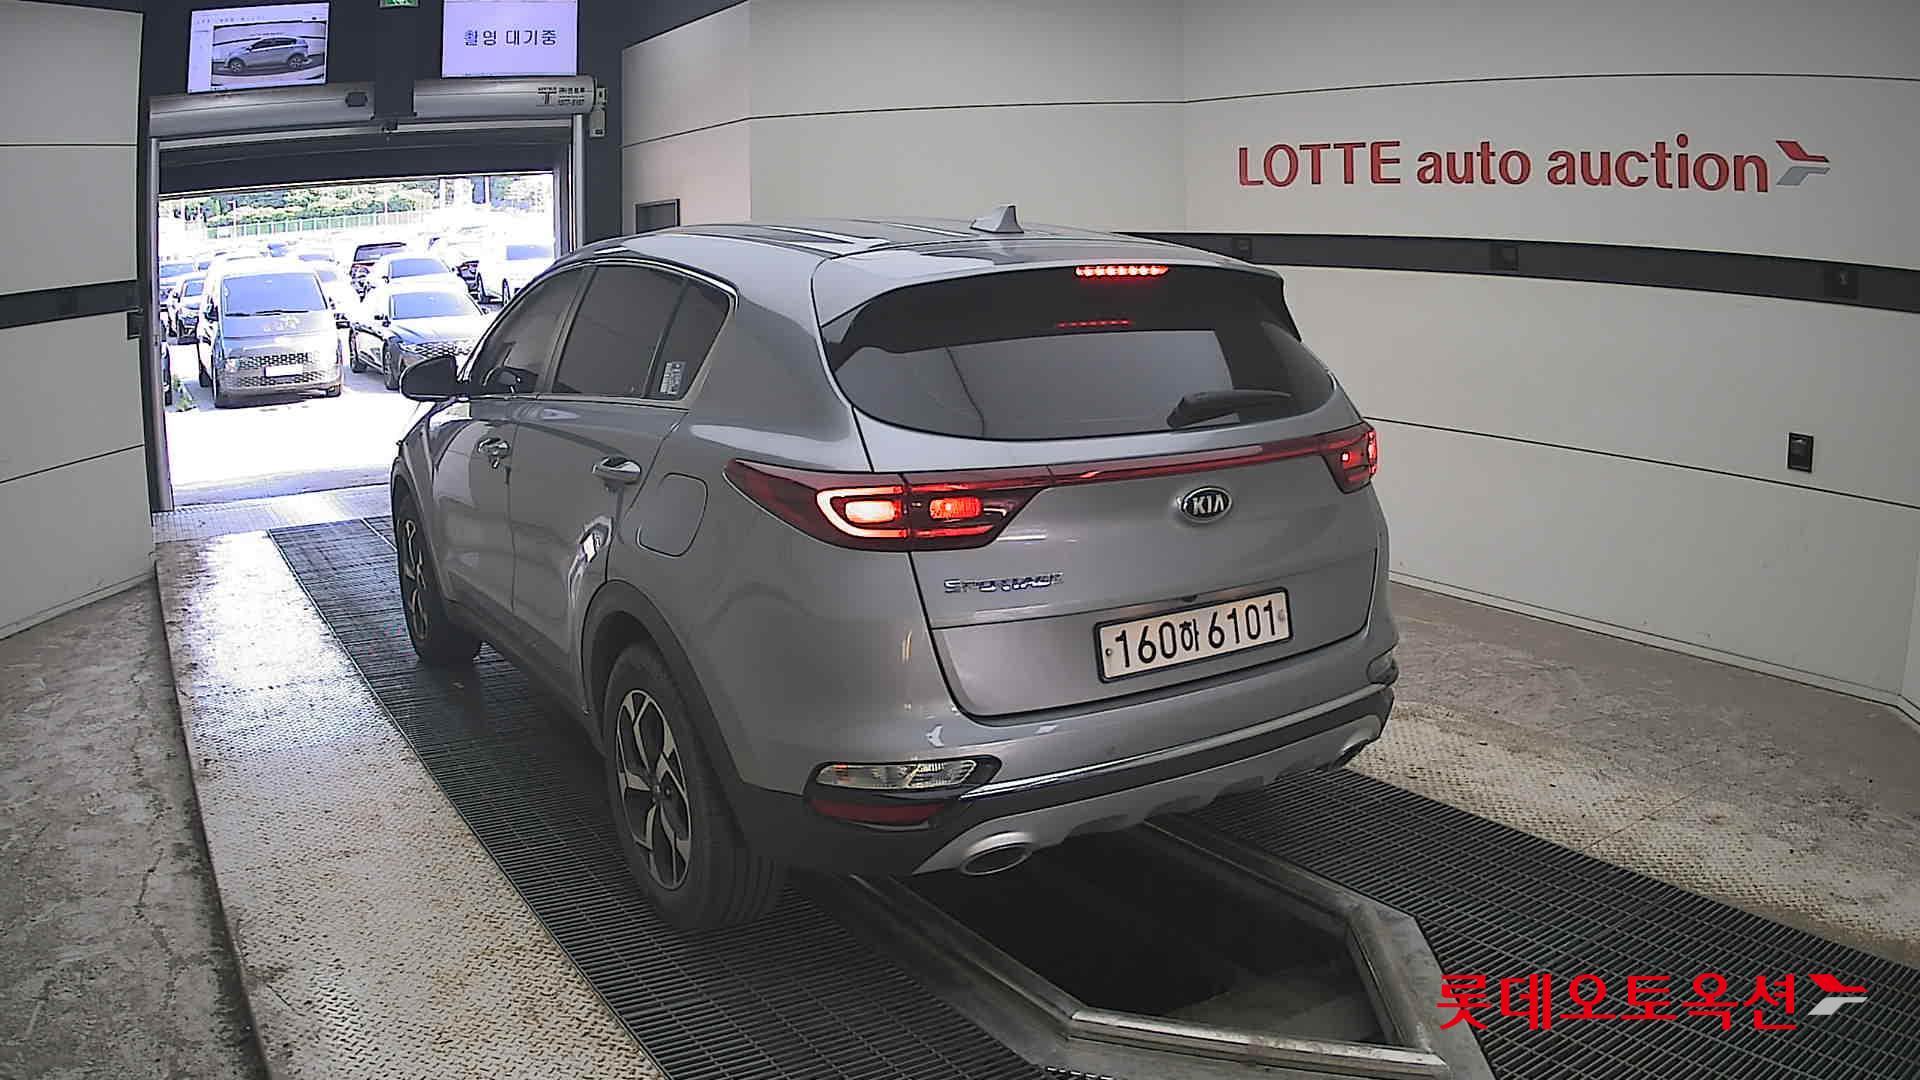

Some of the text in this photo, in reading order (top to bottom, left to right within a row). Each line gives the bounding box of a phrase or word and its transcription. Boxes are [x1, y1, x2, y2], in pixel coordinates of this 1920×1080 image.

[505, 29, 557, 46] 대기중
[1239, 134, 1769, 193] LOTTE auto auction
[1192, 494, 1225, 515] KIA
